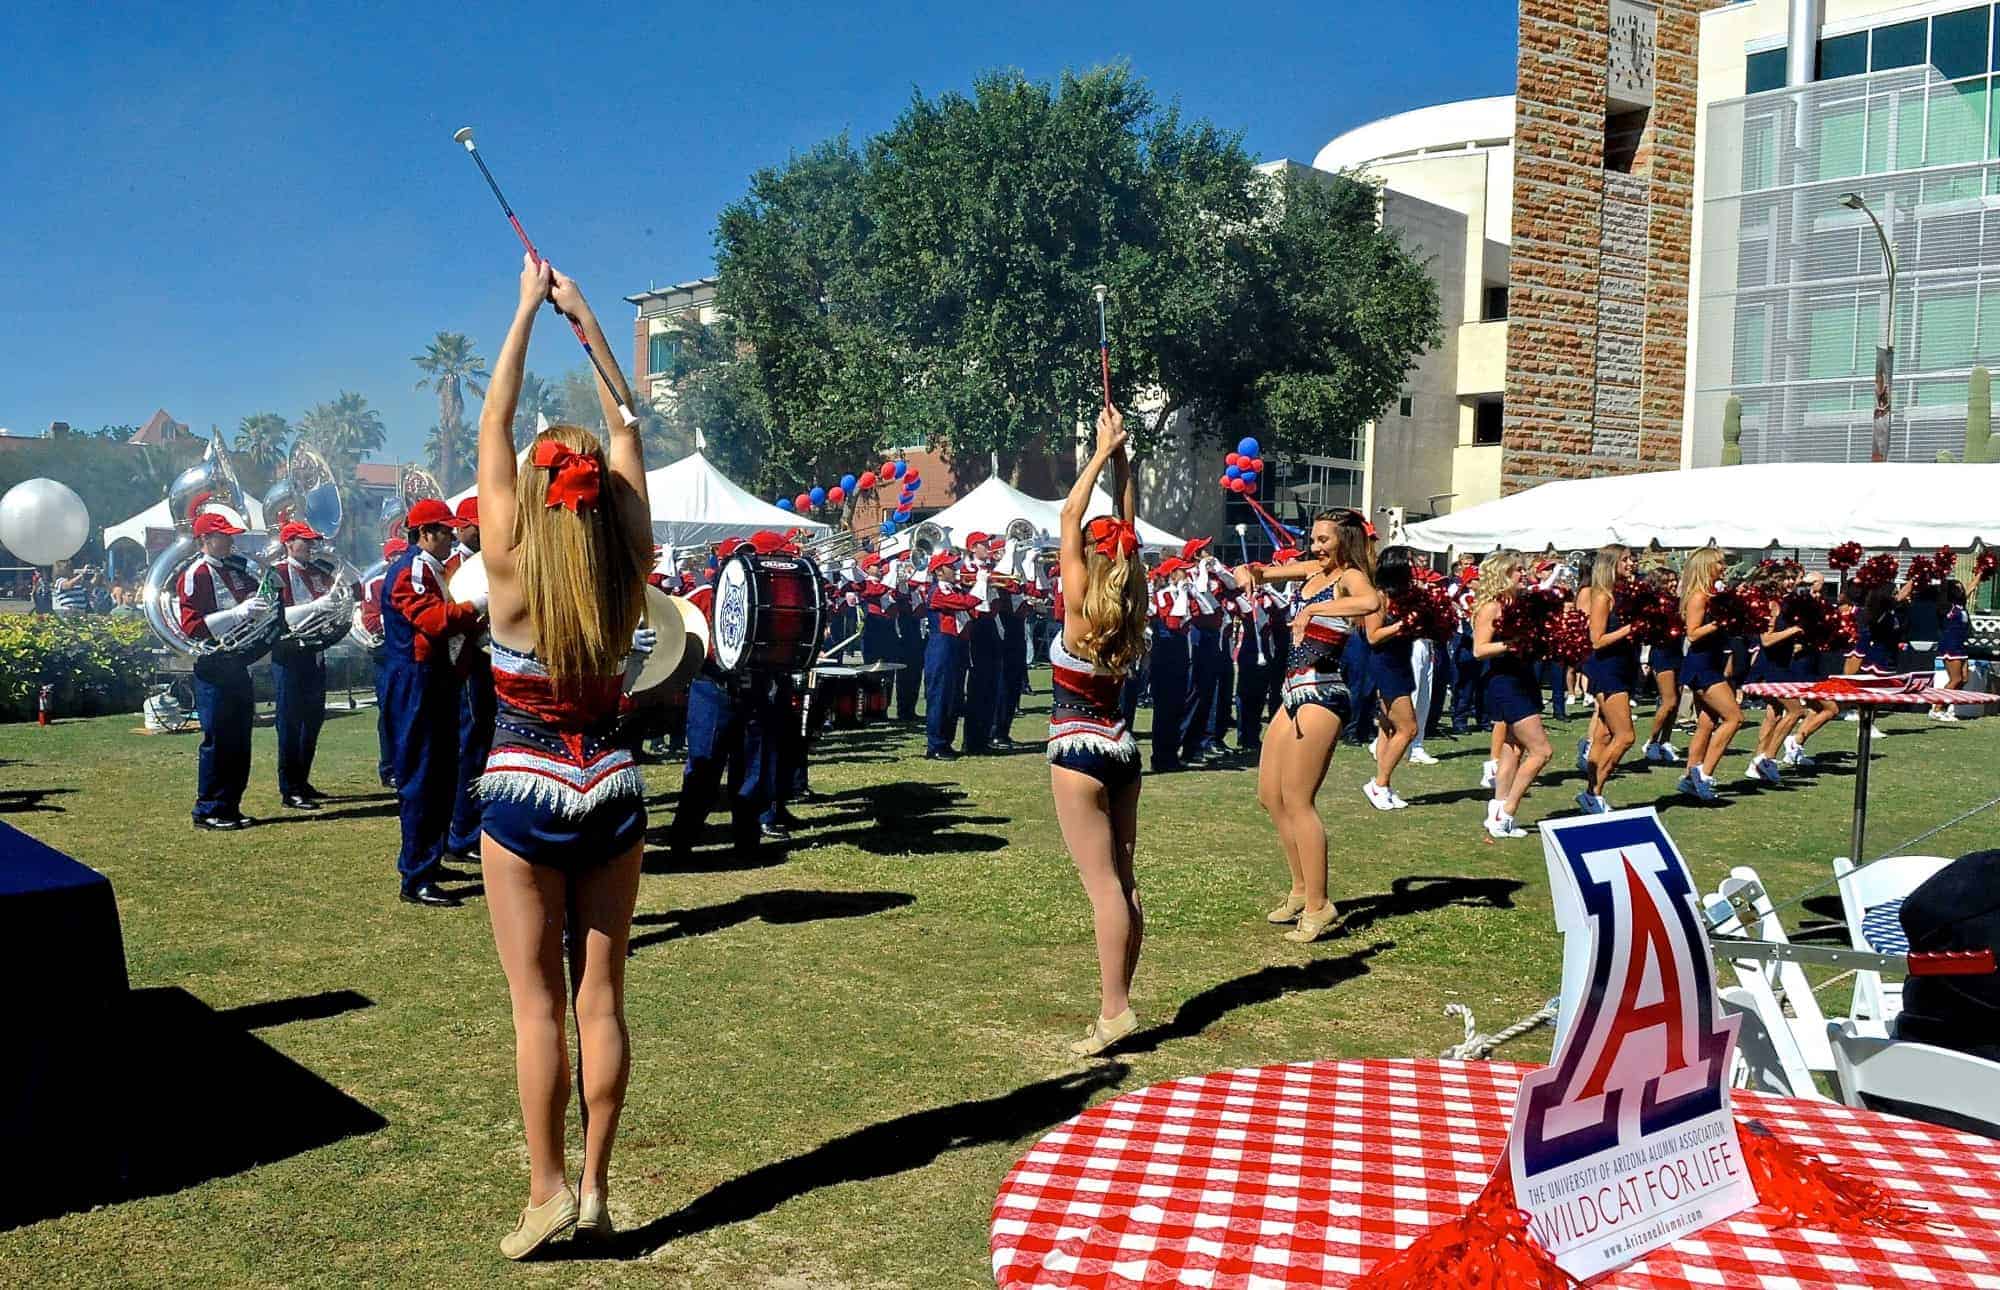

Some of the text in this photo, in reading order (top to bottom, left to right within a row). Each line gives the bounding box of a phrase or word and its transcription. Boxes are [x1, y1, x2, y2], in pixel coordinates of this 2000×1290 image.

[1541, 842, 1711, 1142] A
[1528, 1185, 1546, 1206] THE
[1548, 1166, 1598, 1199] UNIVERSITY
[1600, 1161, 1611, 1181] OF
[1613, 1148, 1648, 1175] ARIZONA
[1648, 1136, 1678, 1160] ALUMNI
[1532, 1175, 1642, 1249] WILDCAT
[1645, 1159, 1696, 1207] FOR
[1603, 1208, 1704, 1258] www.ArizonaAlumni.com
